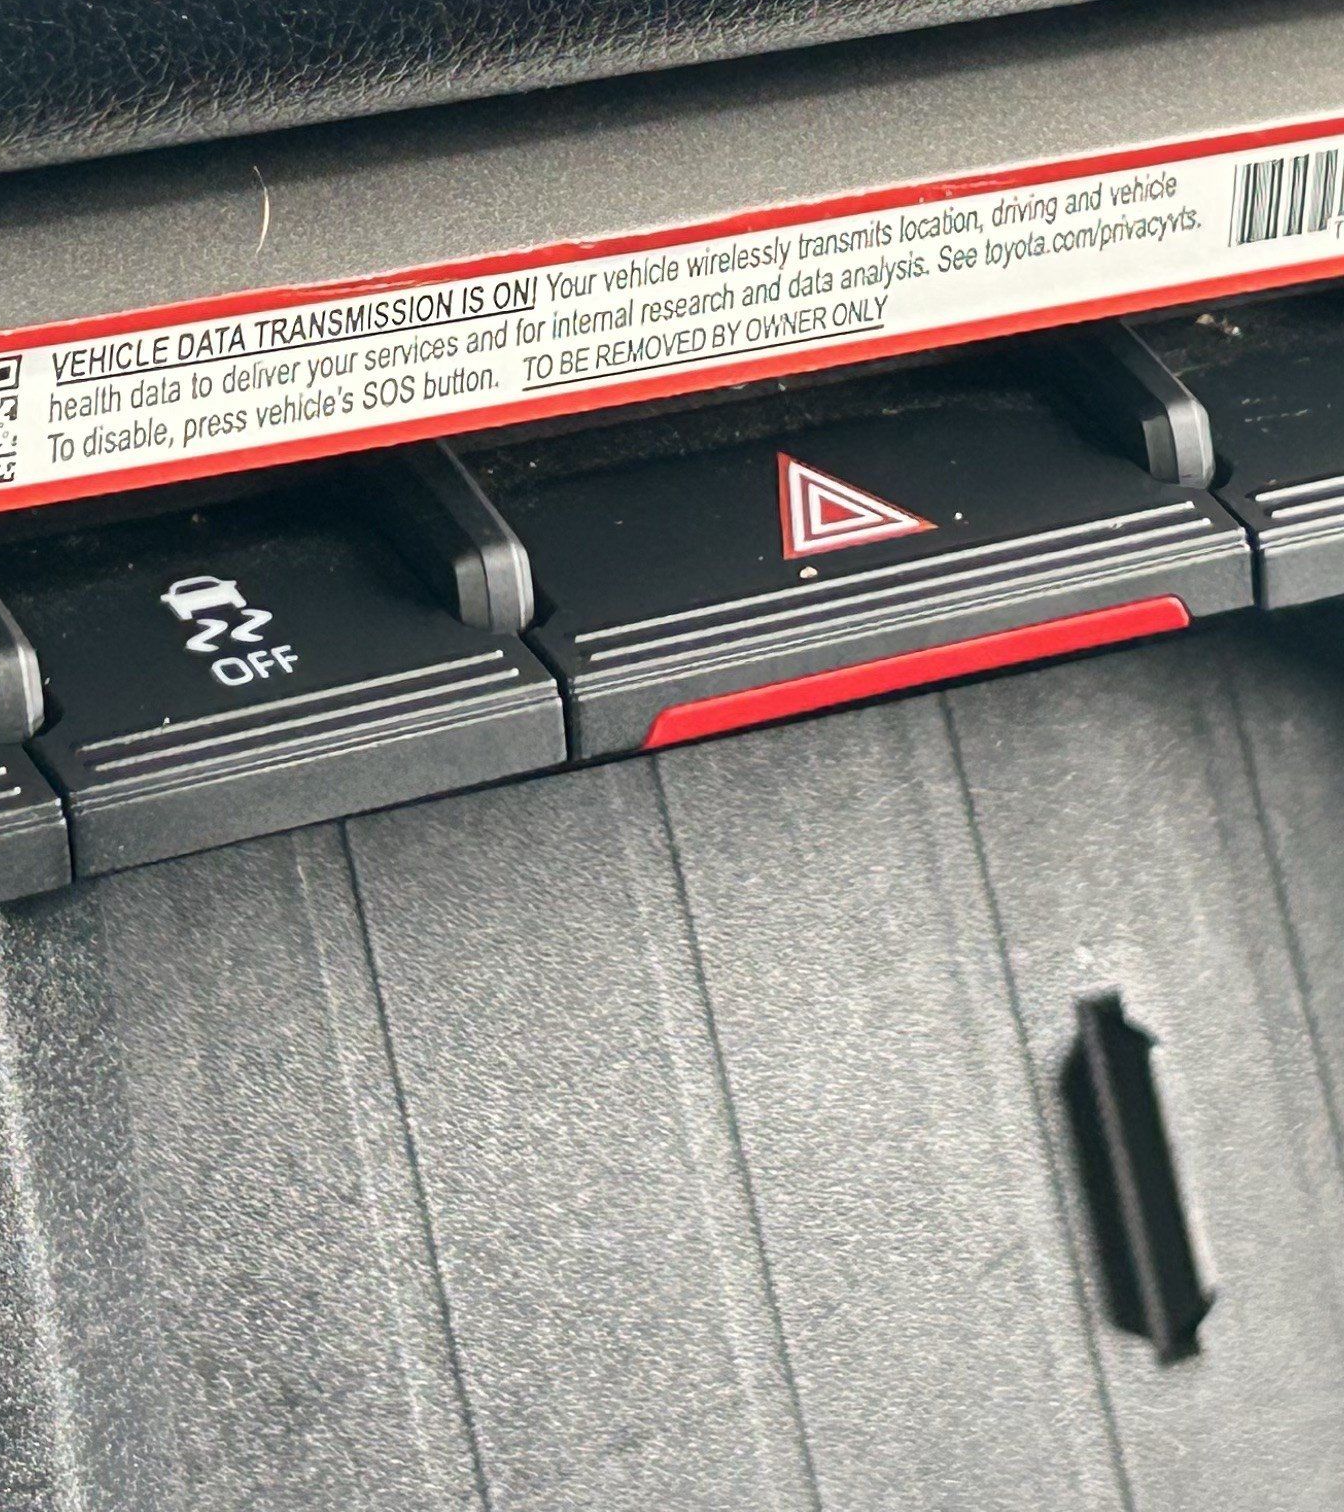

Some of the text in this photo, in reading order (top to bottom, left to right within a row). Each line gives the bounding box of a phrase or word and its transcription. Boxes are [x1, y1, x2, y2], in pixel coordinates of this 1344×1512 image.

[48, 205, 1202, 423] health data to deliver your services and for internal research and data analysis. See toyota.com/privacyvts.
[52, 336, 170, 380] VEHICLE
[178, 323, 245, 360] DATA
[254, 290, 453, 348] TRANSMISSION
[462, 286, 484, 313] IS
[547, 272, 597, 301] Your
[604, 255, 679, 292] vehicle
[687, 236, 791, 278] wirelessly
[799, 220, 892, 260] transmits
[899, 206, 984, 243] location,
[992, 193, 1057, 227] driving
[1065, 182, 1102, 214] and
[1110, 171, 1177, 206] vehicle
[47, 295, 888, 464] To disable, press vehicle's SOS button. TO BE REMOVED BY OWNER ONLY
[211, 645, 298, 685] OFF
